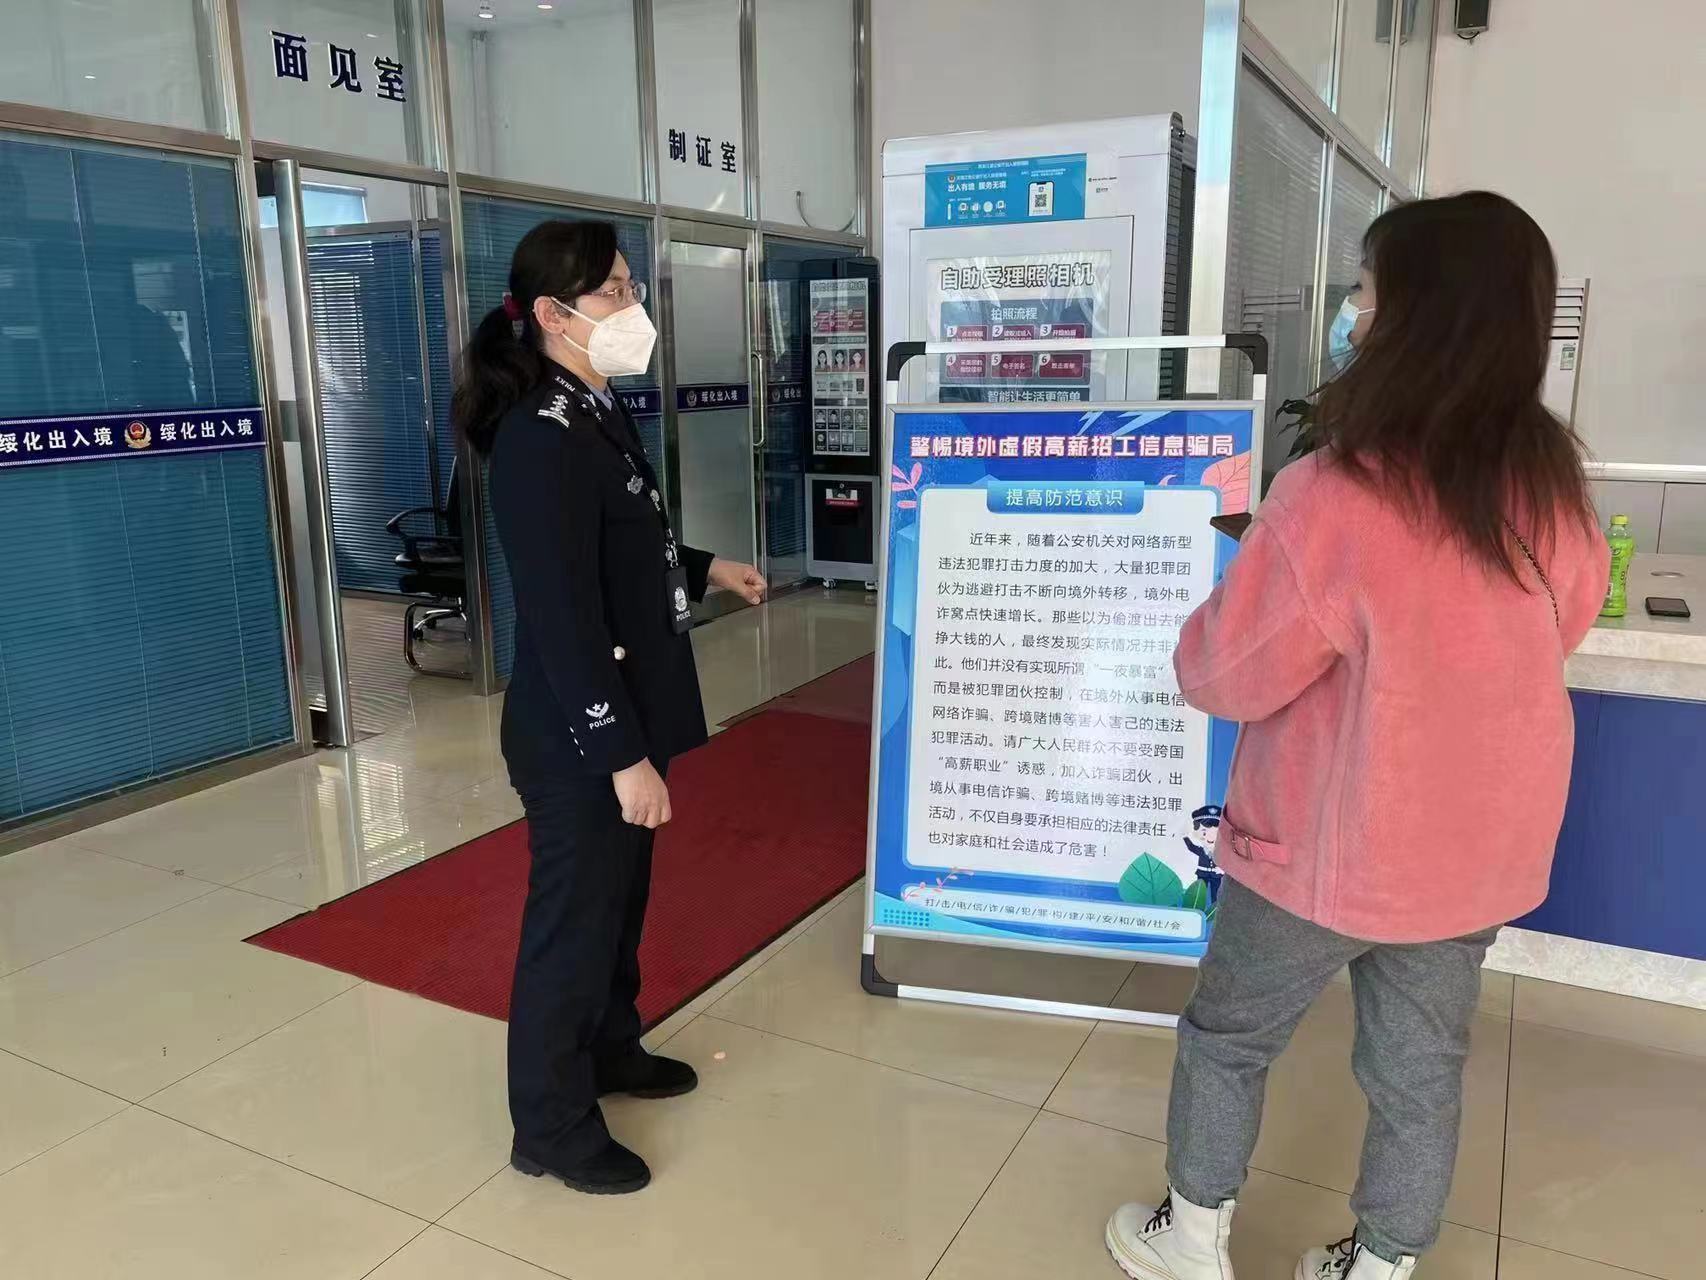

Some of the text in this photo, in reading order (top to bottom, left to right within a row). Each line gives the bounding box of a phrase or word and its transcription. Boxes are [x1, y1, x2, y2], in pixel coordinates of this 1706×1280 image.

[270, 30, 406, 102] 面见室
[668, 128, 736, 173] 制证室
[941, 262, 1095, 290] 自助受理照相机
[991, 307, 1038, 320] 拍照流程
[987, 390, 1081, 402] 智能让生活更简单
[0, 427, 114, 454] 绥化出入境
[160, 418, 254, 441] 绥化出入境
[910, 434, 1234, 459] 警惕境外虚假高薪招工信息骗局
[1005, 487, 1124, 507] 提高防范意识
[969, 531, 1192, 550] 近年来，随着公安机关对网络新型
[938, 556, 1191, 577] 违法犯罪打击力度的加大，大量犯罪团
[937, 581, 1190, 602] 伙为逃避打击不断向境外转移，境外电
[675, 610, 691, 621] POLICE
[935, 631, 1178, 655] 挣大钱的人，最终发现实际情况并非
[932, 680, 1186, 707] 而是被犯罪团伙控制，在境外从事电信
[588, 715, 616, 730] POLICE
[932, 705, 1185, 733] 网络诈骗、跨境赌博等害人害己的违法
[931, 730, 1184, 759] 犯罪活动。请广大人民群众不要受跨国
[929, 780, 1182, 812] 境从事电信诈骗、跨境赌博等违法犯罪
[928, 805, 1176, 838] 活动，不仅自身要承担相应的法律责任，
[928, 830, 1108, 858] 也对家庭和社会造成了危害！
